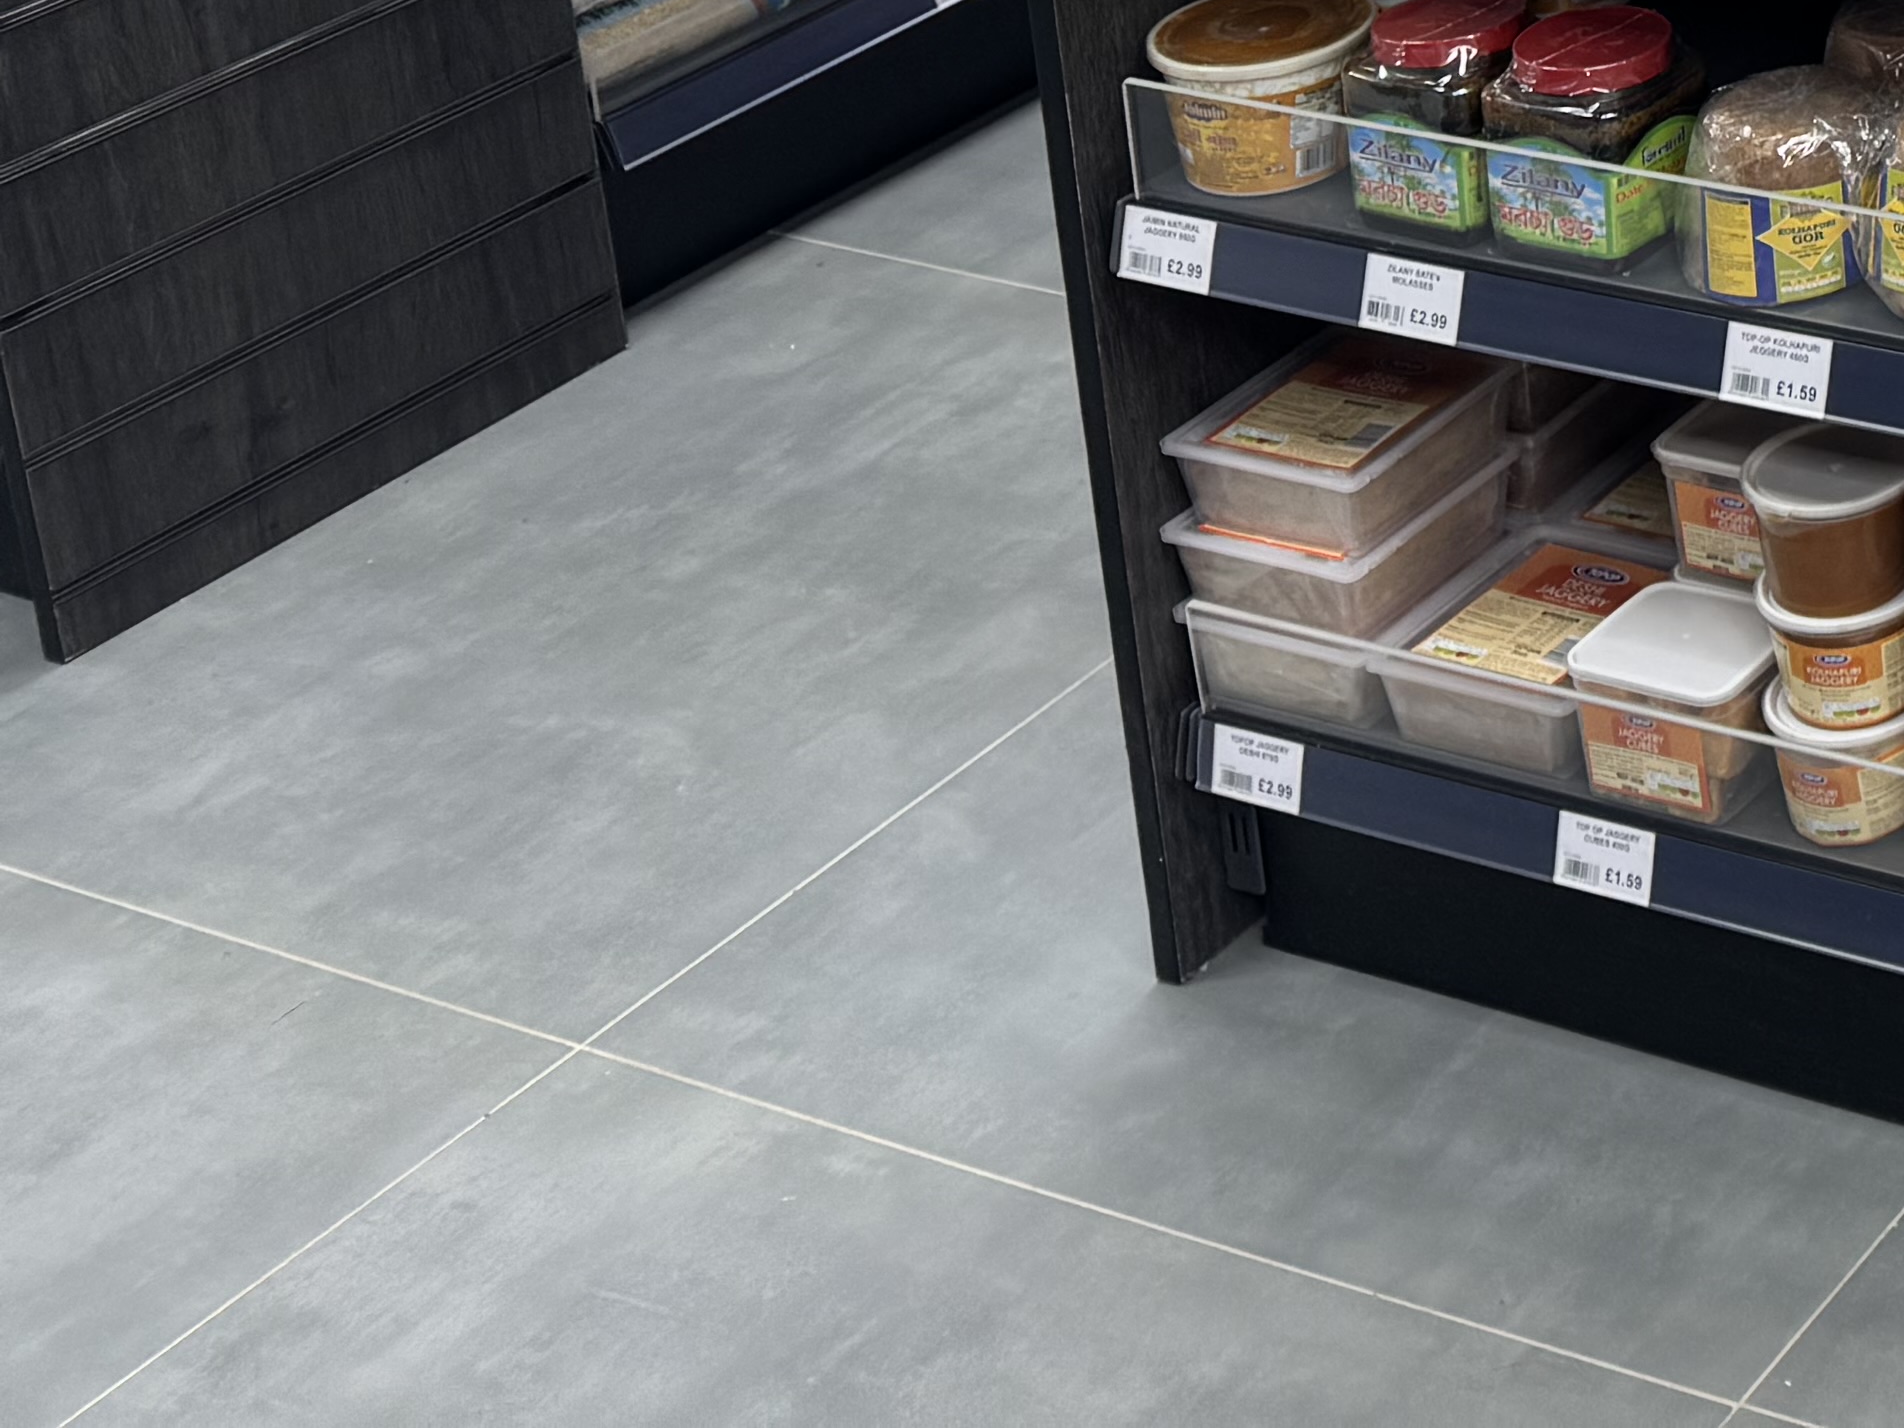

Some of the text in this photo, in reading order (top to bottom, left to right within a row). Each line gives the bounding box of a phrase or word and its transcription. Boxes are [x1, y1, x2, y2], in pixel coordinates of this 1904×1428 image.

[1360, 139, 1437, 173] Zilany
[1502, 163, 1585, 199] Zilany
[1167, 258, 1203, 278] £2.99
[1409, 308, 1447, 331] £2.99
[1776, 381, 1817, 403] £1.59
[1258, 778, 1292, 801] £2.99
[1606, 869, 1642, 891] £1.59
